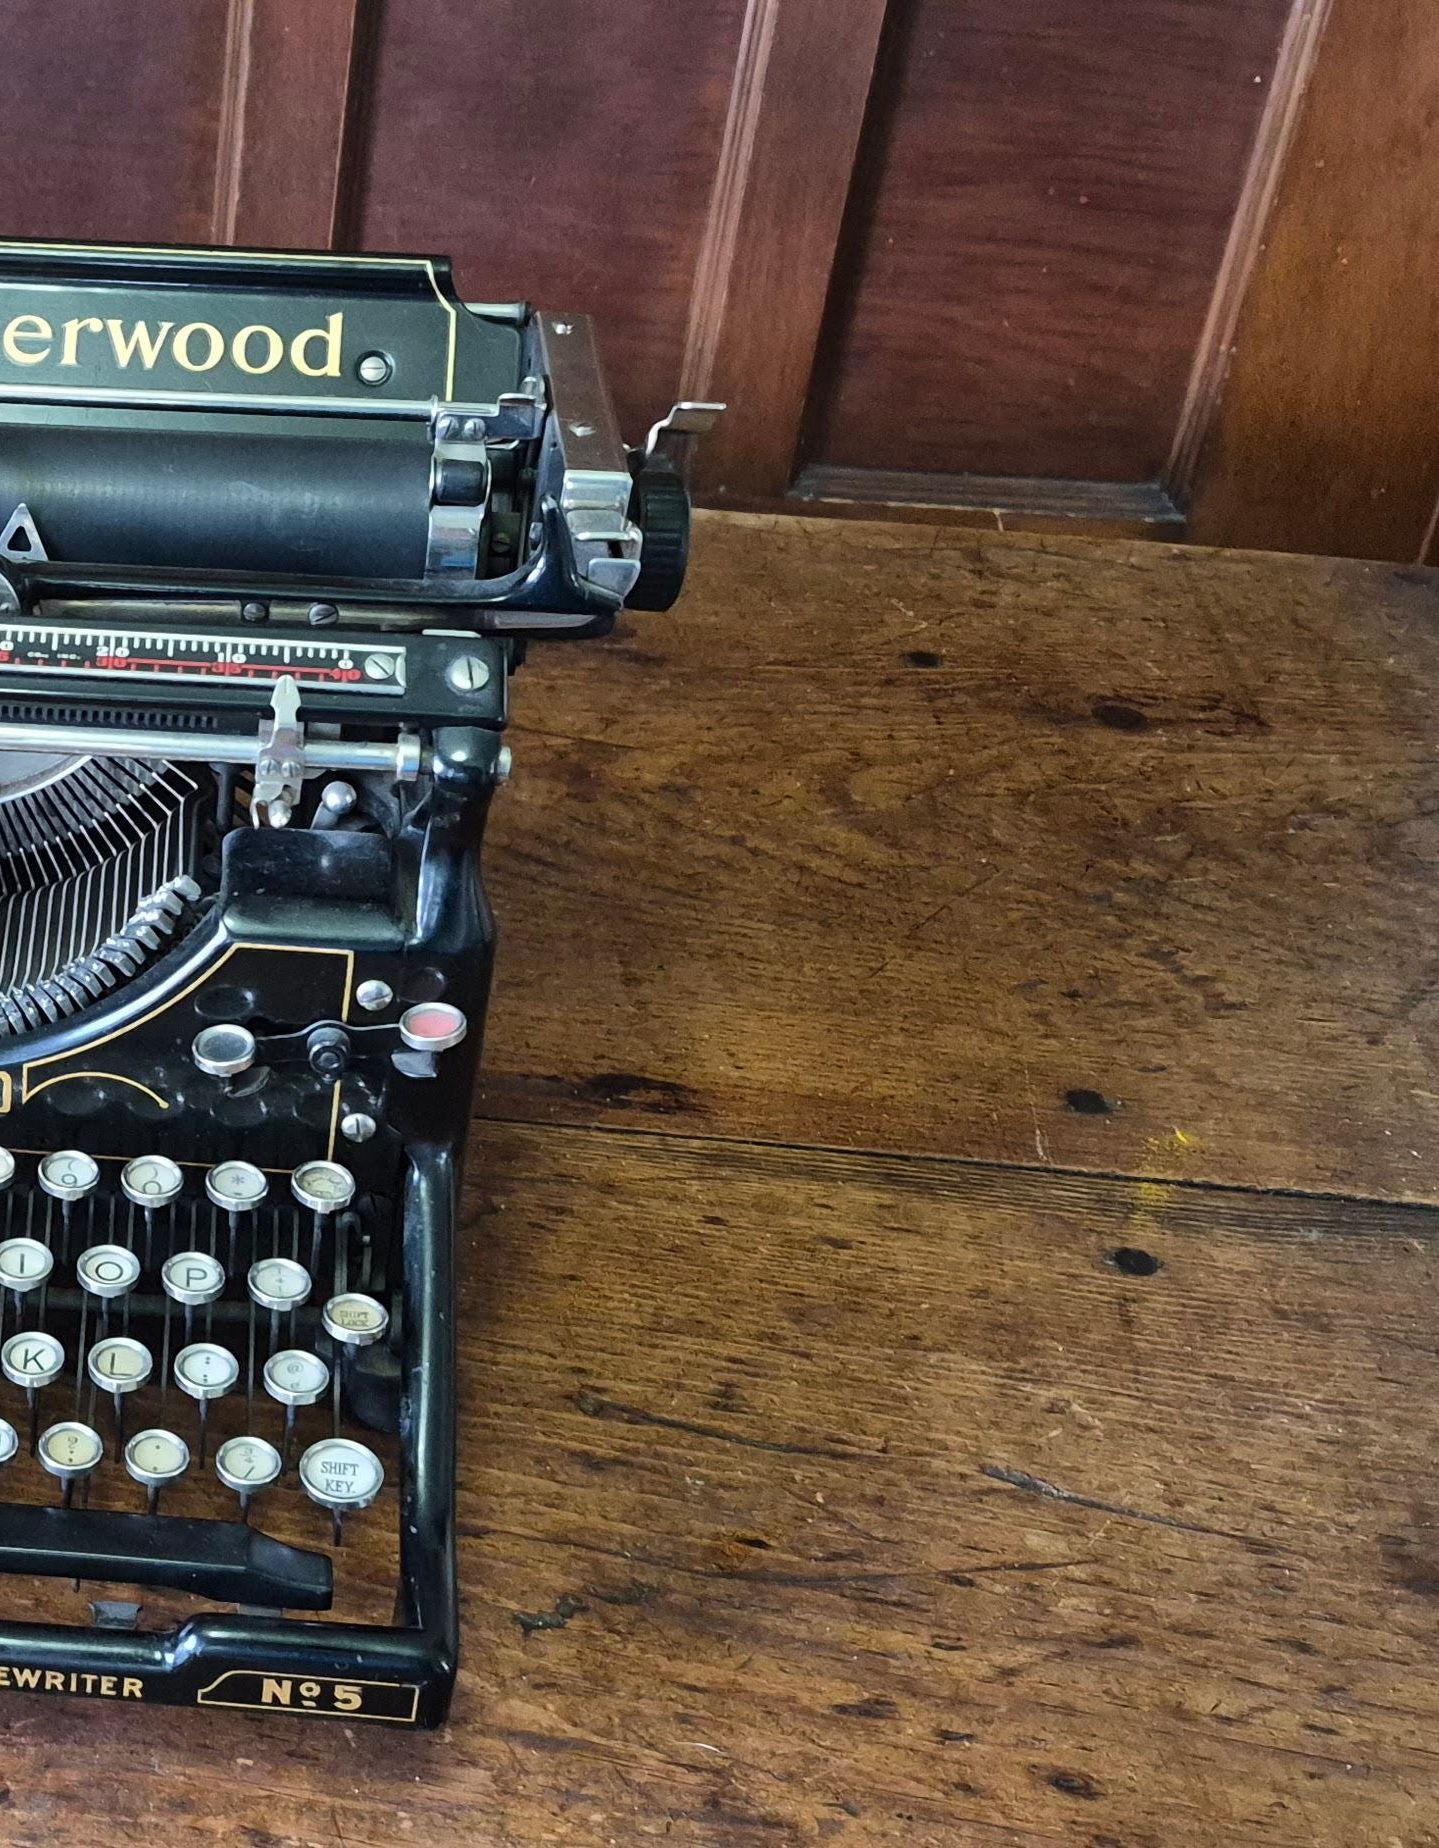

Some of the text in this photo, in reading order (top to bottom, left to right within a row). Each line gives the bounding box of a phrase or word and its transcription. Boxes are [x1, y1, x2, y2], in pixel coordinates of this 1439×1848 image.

[96, 646, 130, 657] 20
[217, 652, 247, 663] 10
[96, 656, 127, 667] 30
[212, 662, 243, 674] 35
[330, 668, 361, 681] 40
[61, 1173, 78, 1187] 9
[18, 1253, 25, 1273] I
[96, 1261, 124, 1283] O
[187, 1267, 207, 1288] P
[341, 1318, 369, 1328] LOCK
[22, 1348, 45, 1371] K
[110, 1352, 133, 1377] L
[320, 1461, 360, 1476] SHIFT
[324, 1480, 356, 1494] KEY.
[334, 1685, 363, 1712] 5
